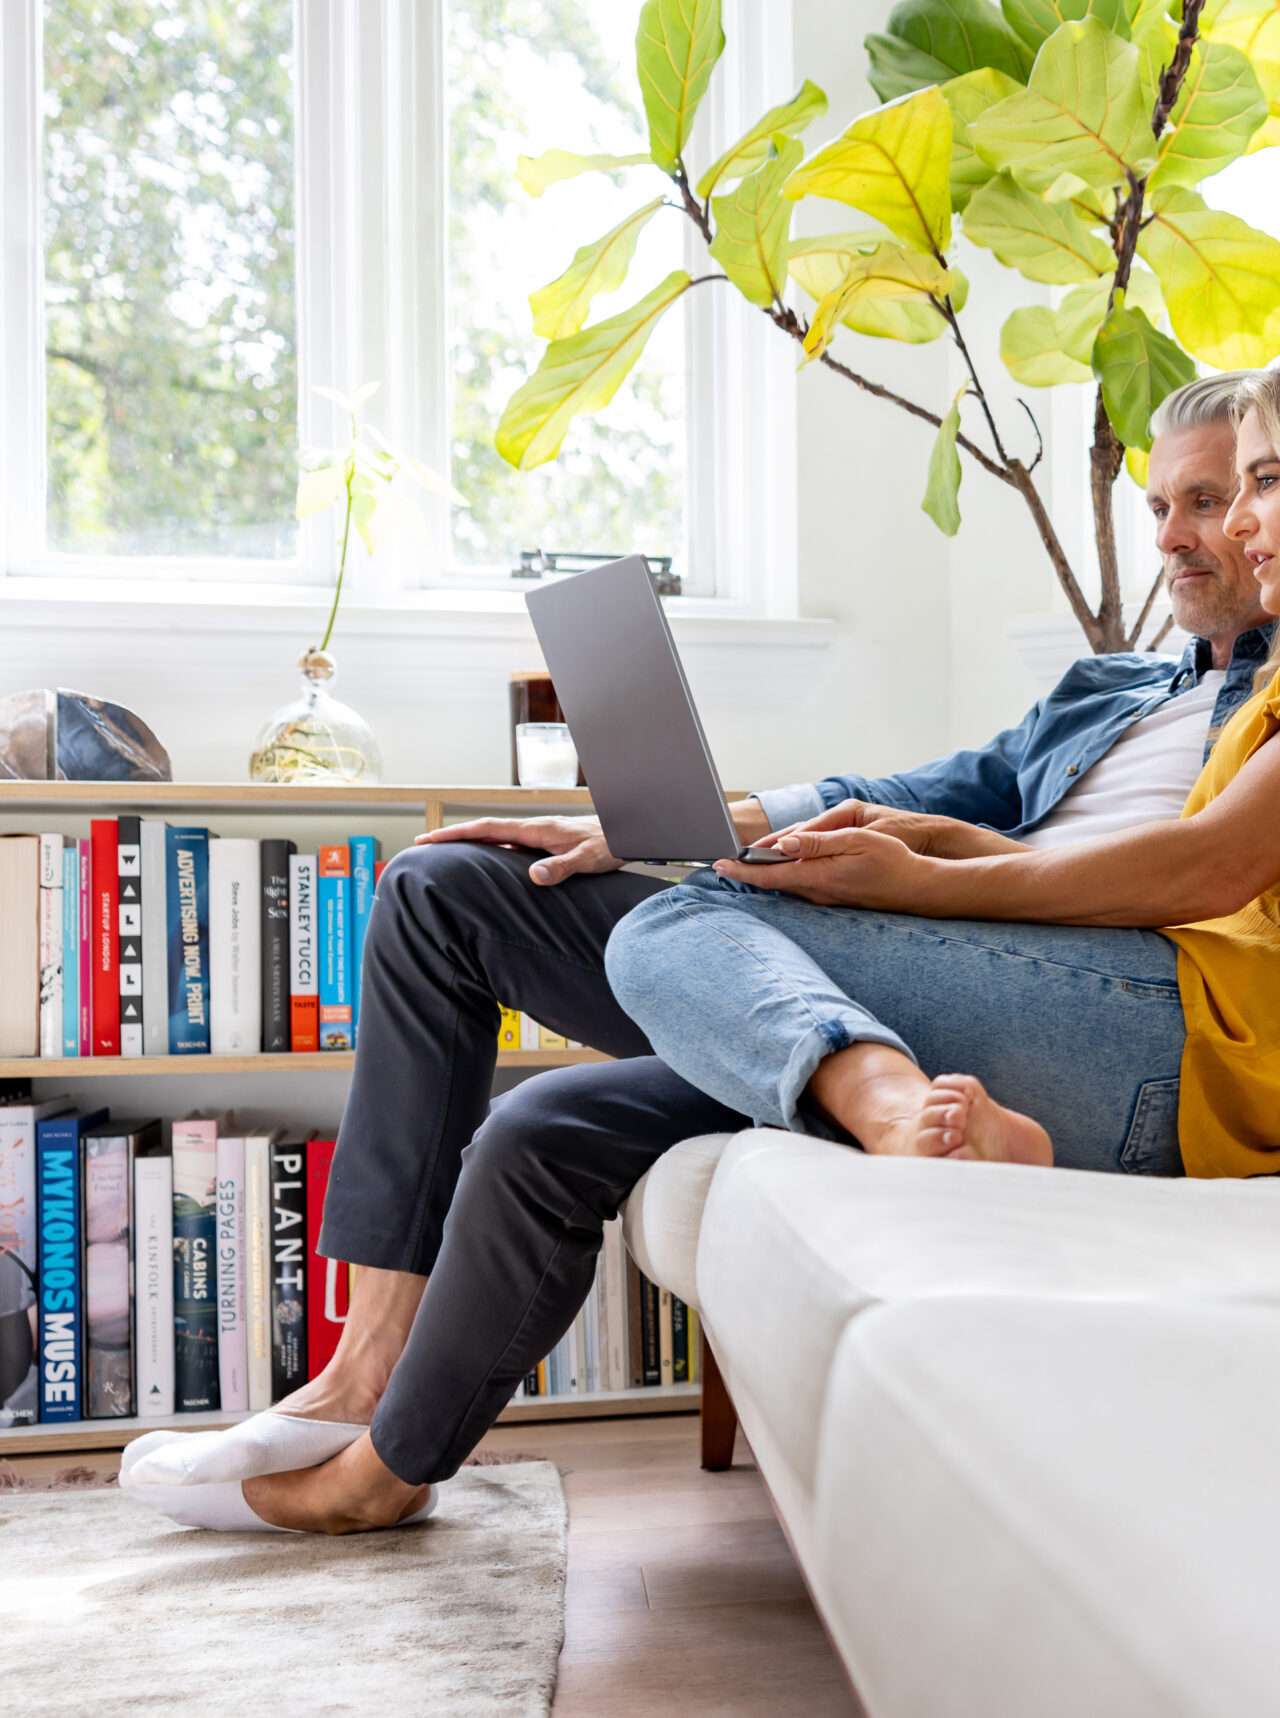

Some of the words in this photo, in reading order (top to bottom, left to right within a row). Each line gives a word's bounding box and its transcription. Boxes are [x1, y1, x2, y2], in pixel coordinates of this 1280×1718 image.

[356, 843, 368, 865] Print
[176, 849, 200, 945] ADVERTISING
[231, 881, 240, 906] Steve
[270, 875, 287, 885] The
[298, 865, 310, 932] STANLEY
[102, 892, 110, 930] STARTUP
[231, 907, 240, 929] Jobs
[267, 907, 288, 919] Sex
[102, 932, 110, 972] LONDON
[230, 931, 240, 942] by
[231, 944, 240, 972] Walter
[184, 944, 202, 982] NOW.
[298, 939, 311, 986] TUCCI
[186, 983, 205, 1026] PRINT
[231, 974, 240, 1015] Isaacson
[272, 963, 281, 1022] SRINIVASAN
[0, 1194, 27, 1255] York
[42, 1150, 76, 1312] MYKONOS
[219, 1179, 235, 1240] PAGES
[273, 1154, 303, 1292] PLANT
[148, 1235, 159, 1301] KINFOLK
[193, 1238, 208, 1300] CABINS
[220, 1247, 238, 1334] TURNING
[44, 1312, 76, 1402] MUSE
[183, 1398, 210, 1407] TASCHEN
